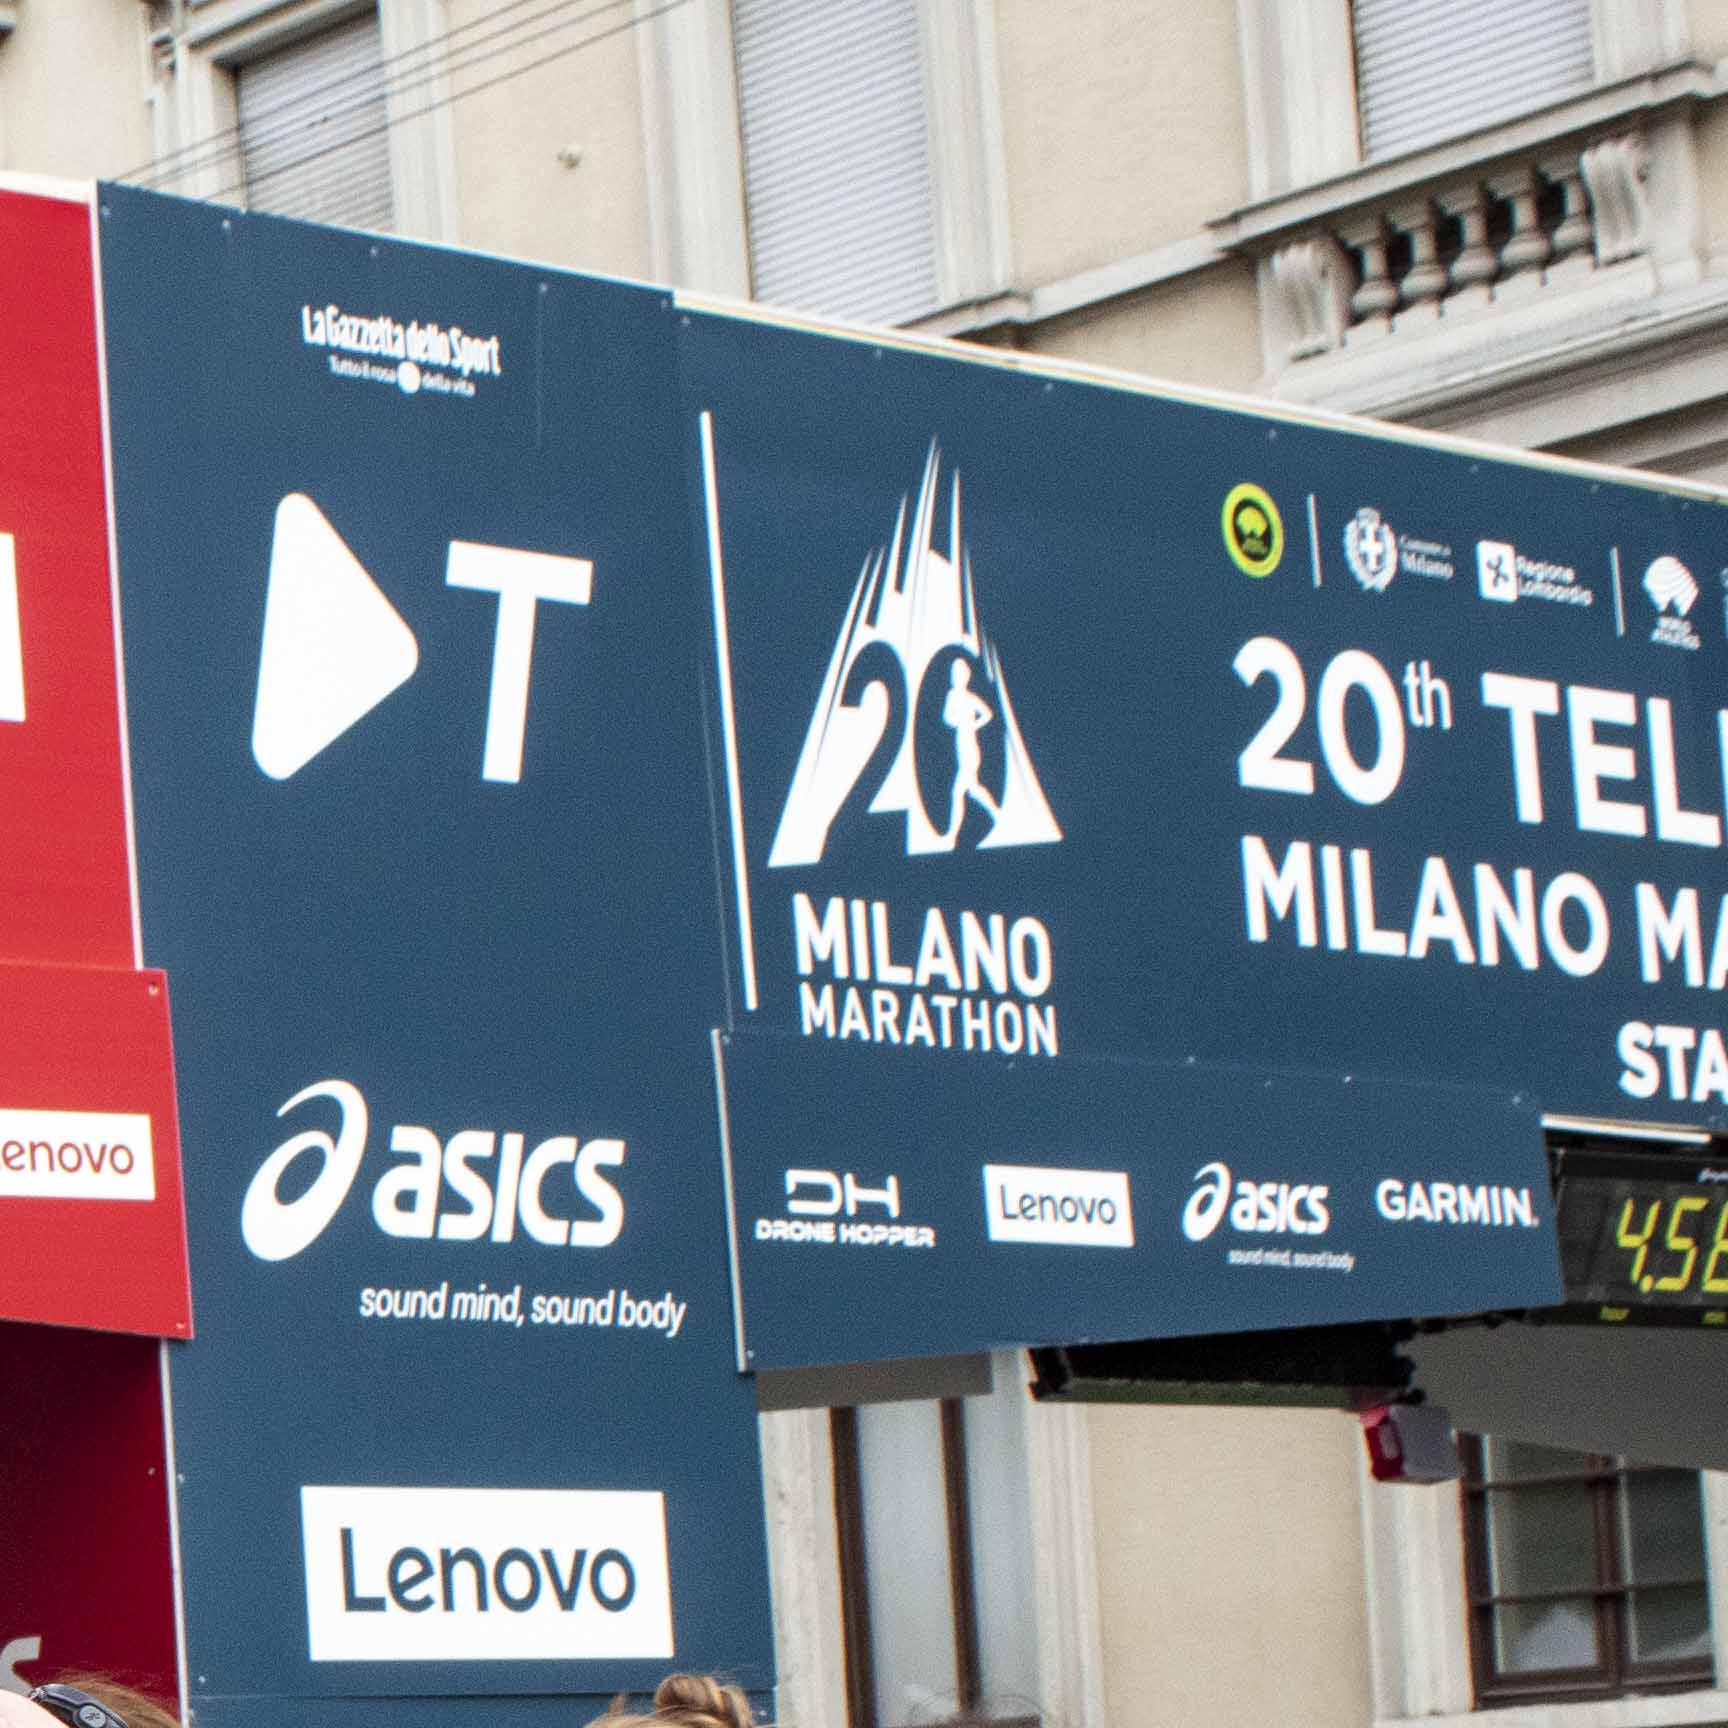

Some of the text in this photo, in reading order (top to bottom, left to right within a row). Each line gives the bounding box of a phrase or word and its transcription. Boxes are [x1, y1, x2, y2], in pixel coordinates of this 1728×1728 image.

[450, 325, 502, 378] Sport
[1231, 635, 1728, 848] 20th TEL
[794, 891, 1052, 997] MILANO
[1241, 835, 1728, 990] MILANO MA
[799, 985, 1059, 1058] MARATHON
[1616, 1021, 1728, 1105] STA
[754, 1219, 936, 1250] DRONE HOPPER
[999, 1183, 1117, 1227] Lenovo
[360, 1282, 447, 1319] sound
[531, 1289, 614, 1326] sound
[617, 1290, 687, 1339] body
[339, 1526, 637, 1614] Lenovo
